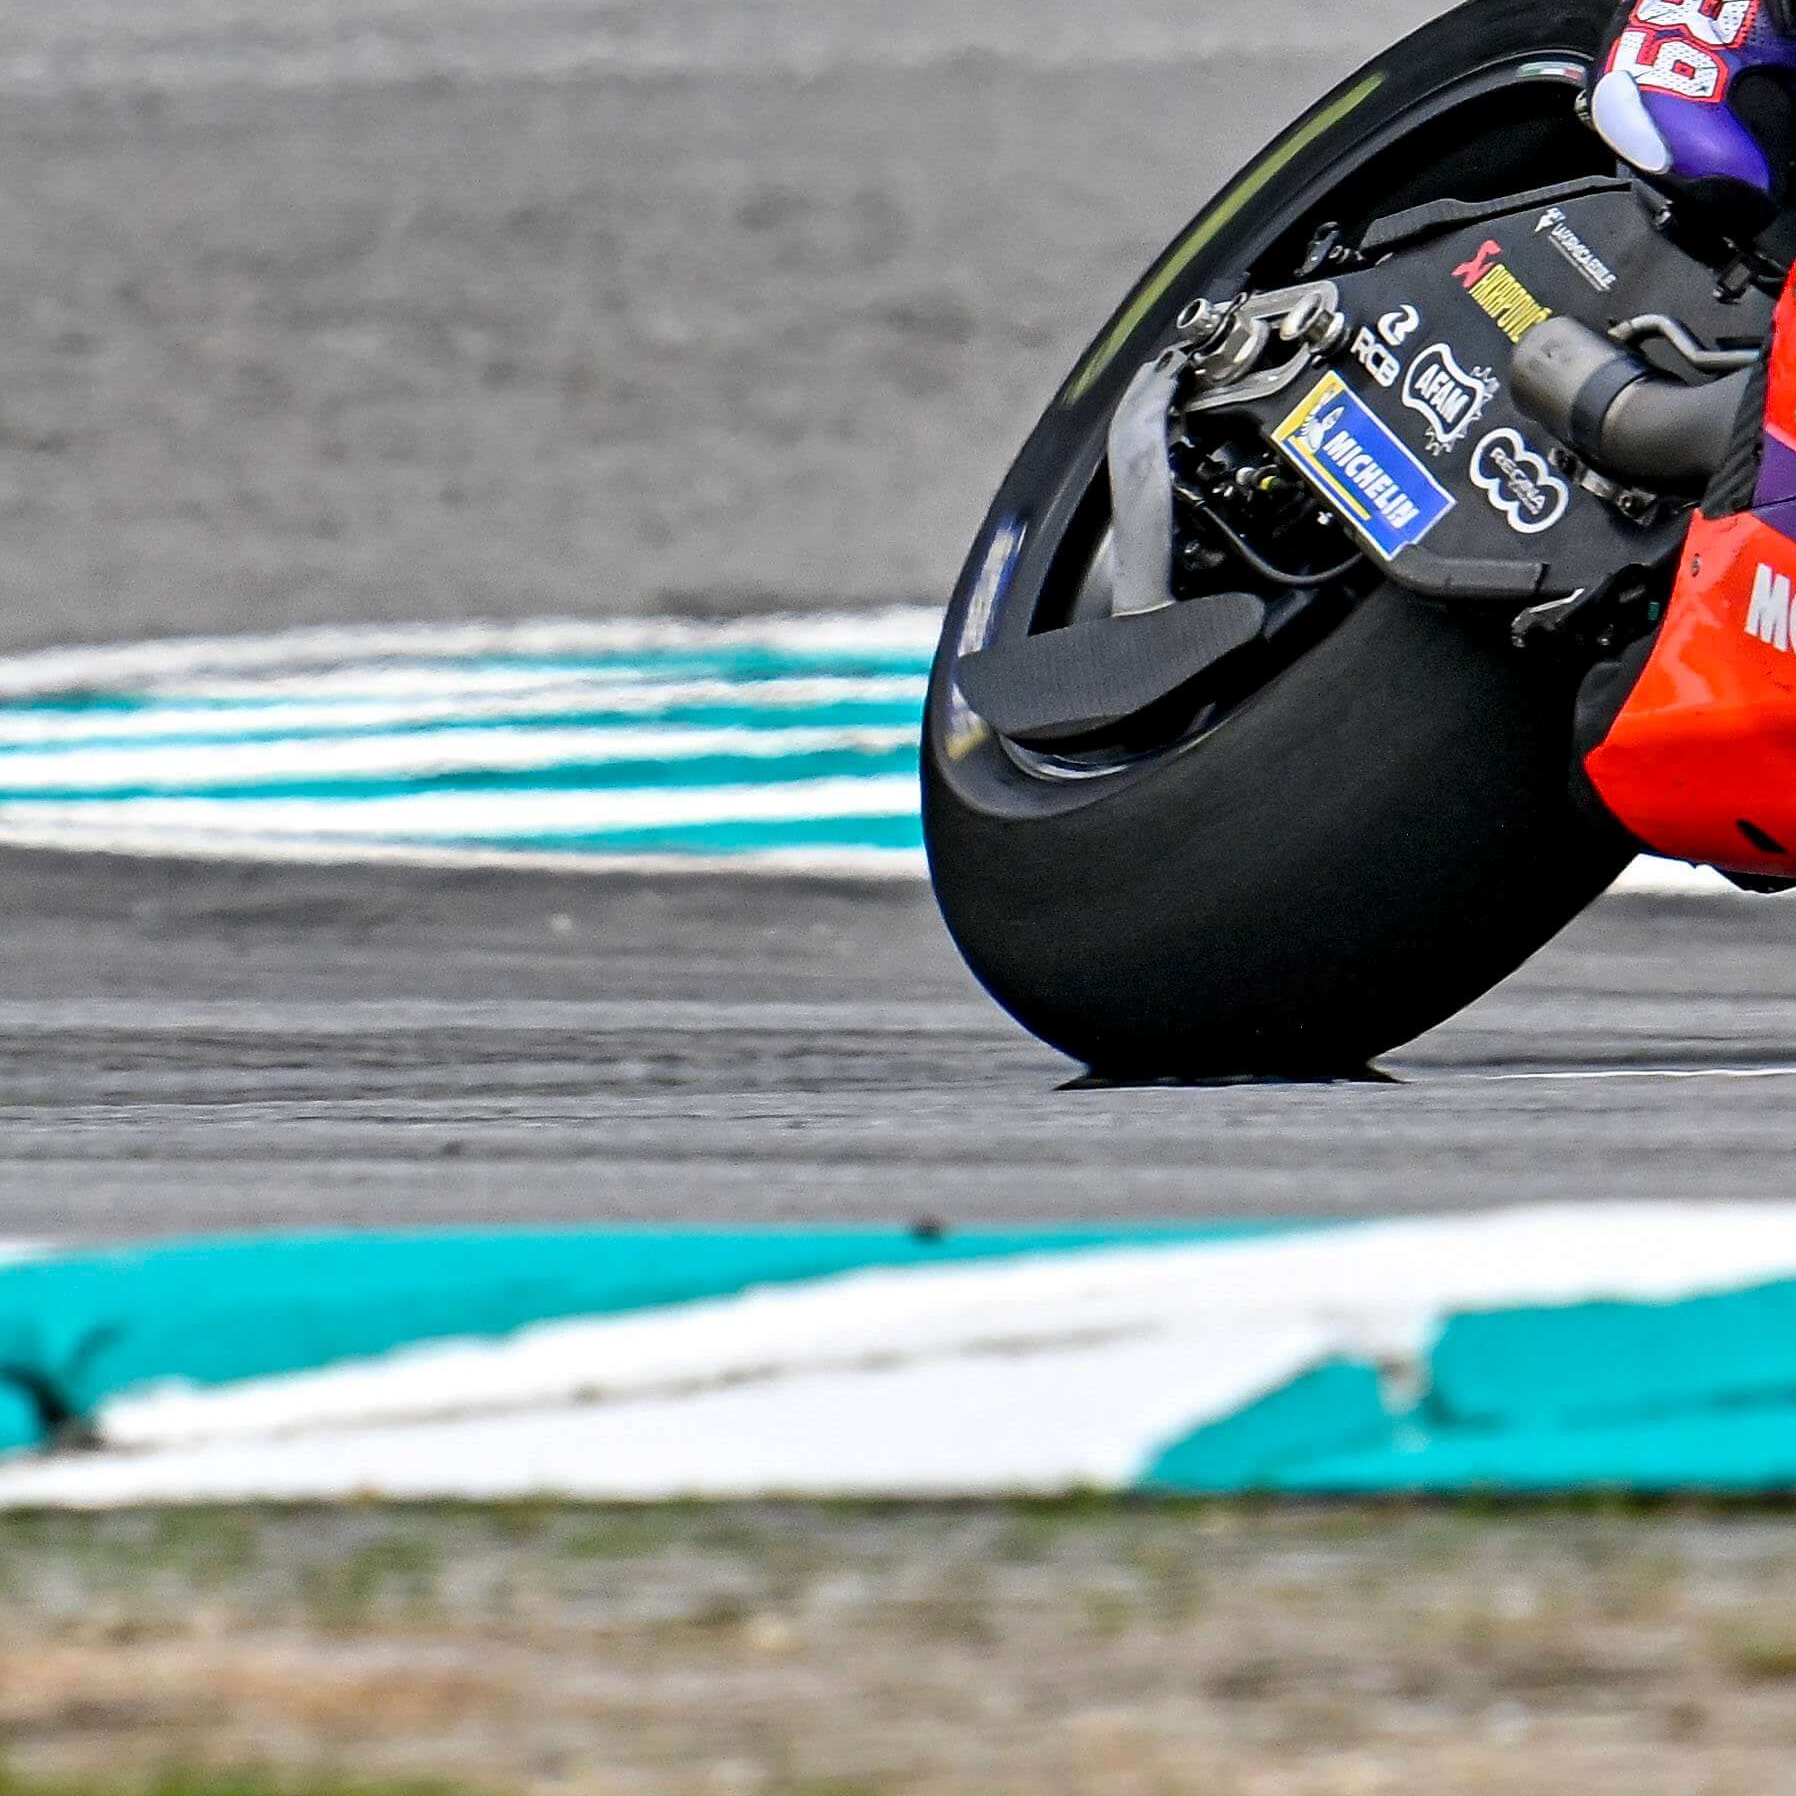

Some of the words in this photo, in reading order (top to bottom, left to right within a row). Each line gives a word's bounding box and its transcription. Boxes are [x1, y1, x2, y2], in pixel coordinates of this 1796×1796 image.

[1351, 326, 1400, 388] RCB
[1414, 363, 1471, 424] AFAM
[1322, 427, 1421, 531] MICHELIN
